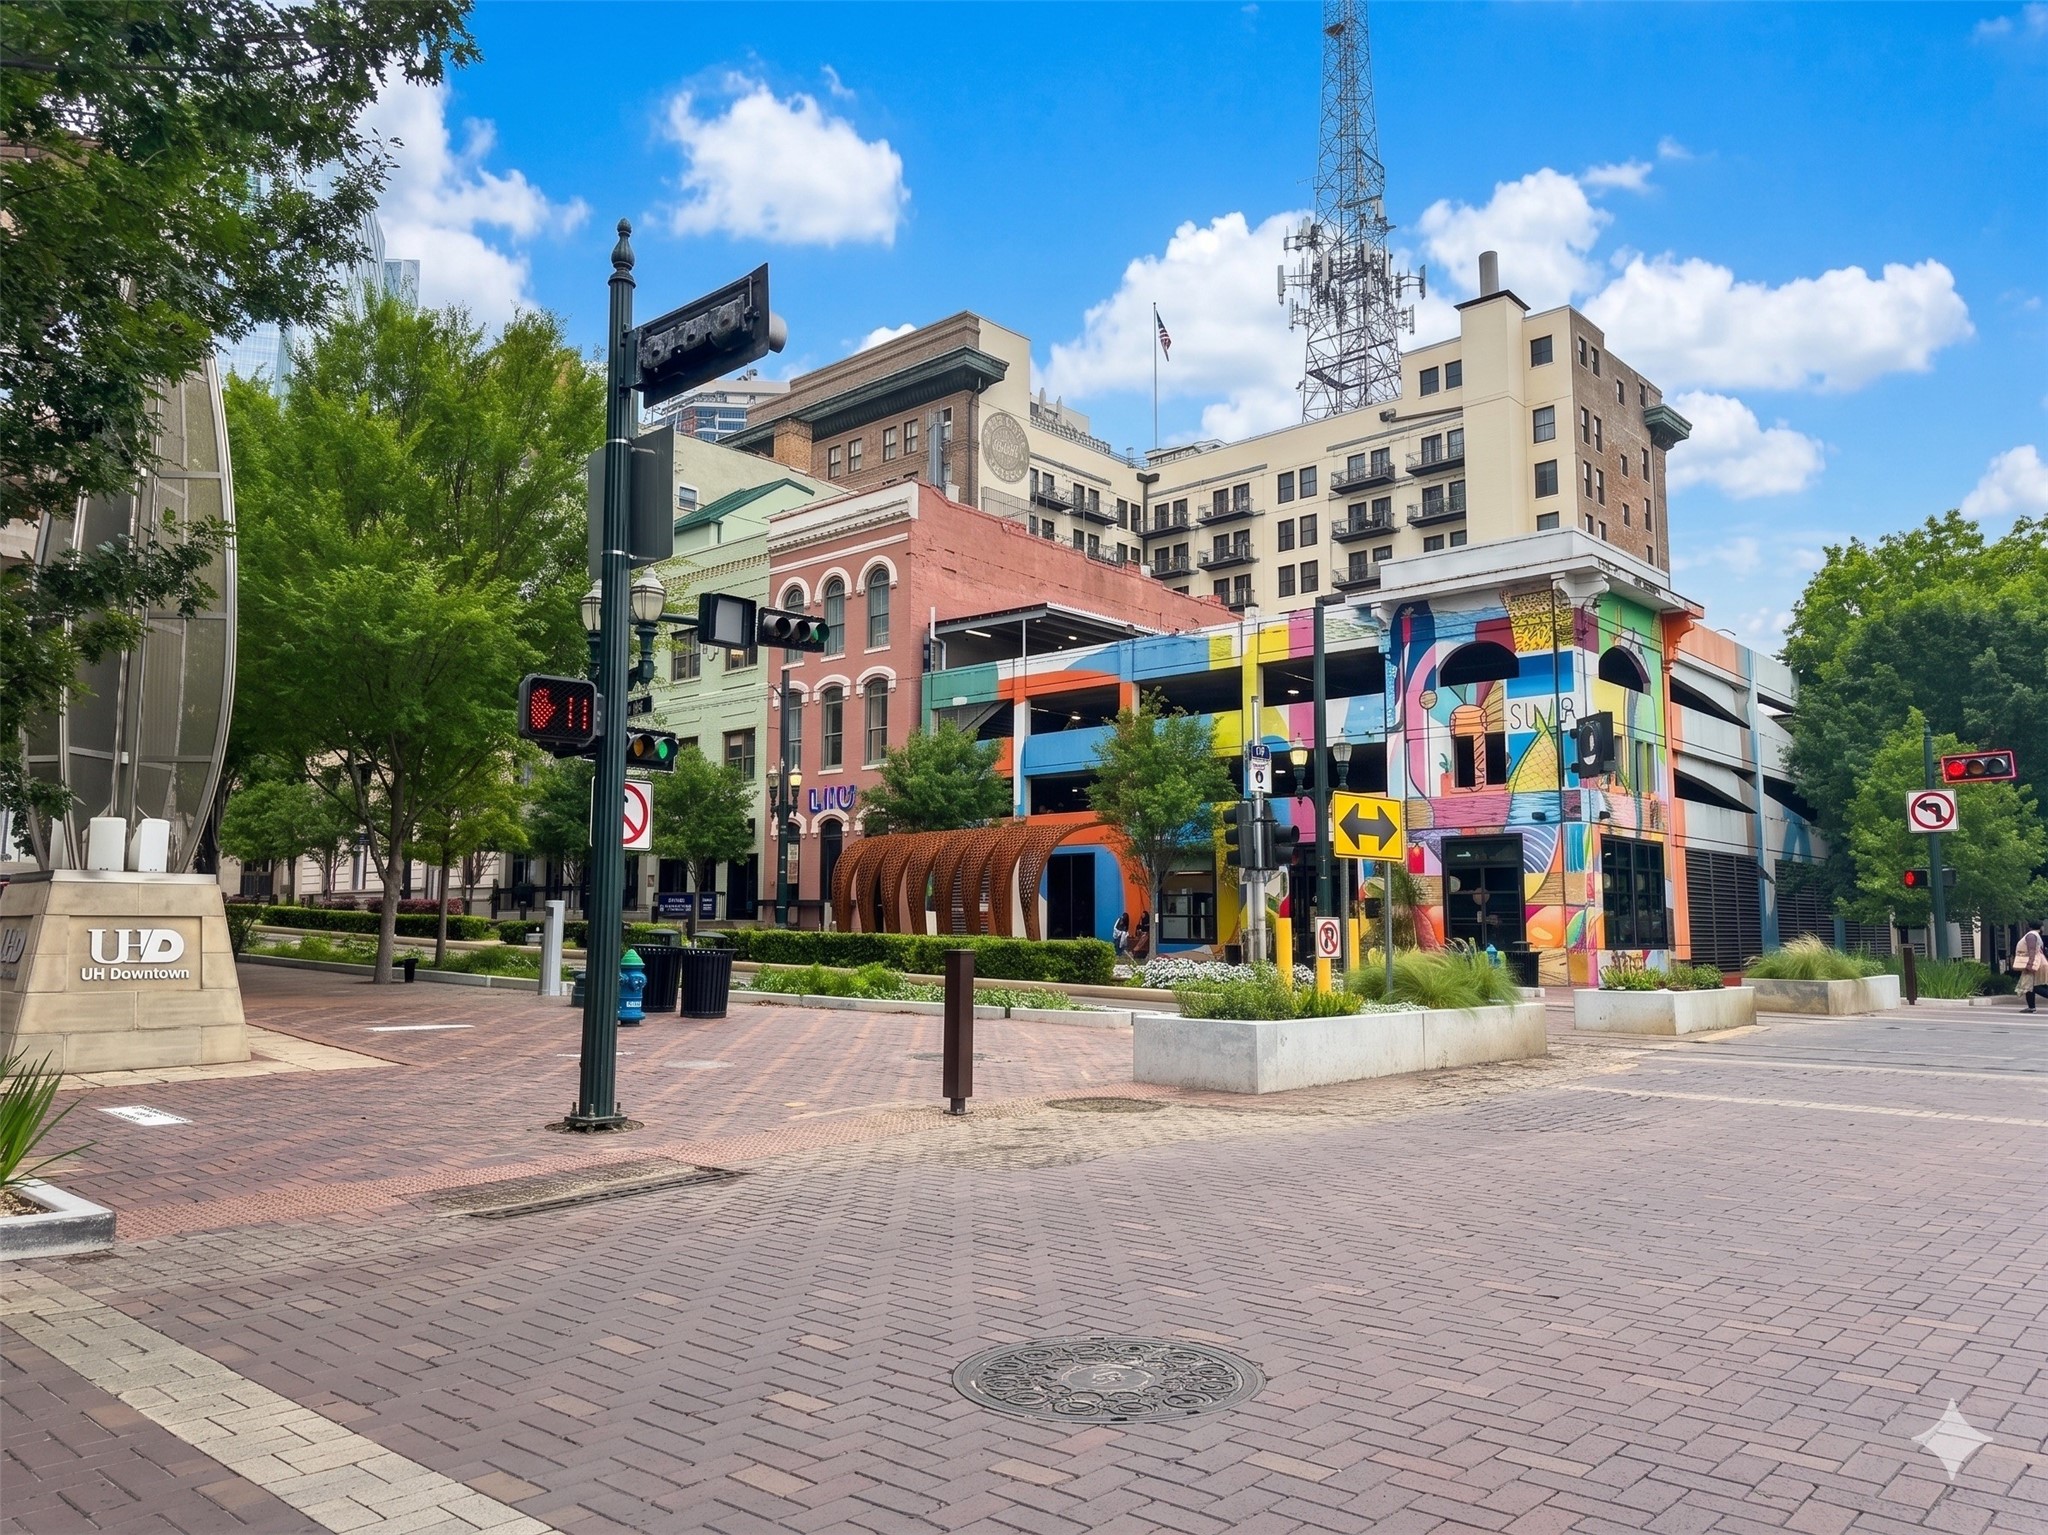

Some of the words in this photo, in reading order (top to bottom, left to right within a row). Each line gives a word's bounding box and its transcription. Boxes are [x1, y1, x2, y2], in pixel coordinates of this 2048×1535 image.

[567, 697, 588, 730] 11
[87, 928, 185, 965] UHD
[81, 967, 105, 980] UH
[110, 967, 189, 980] Downtown
